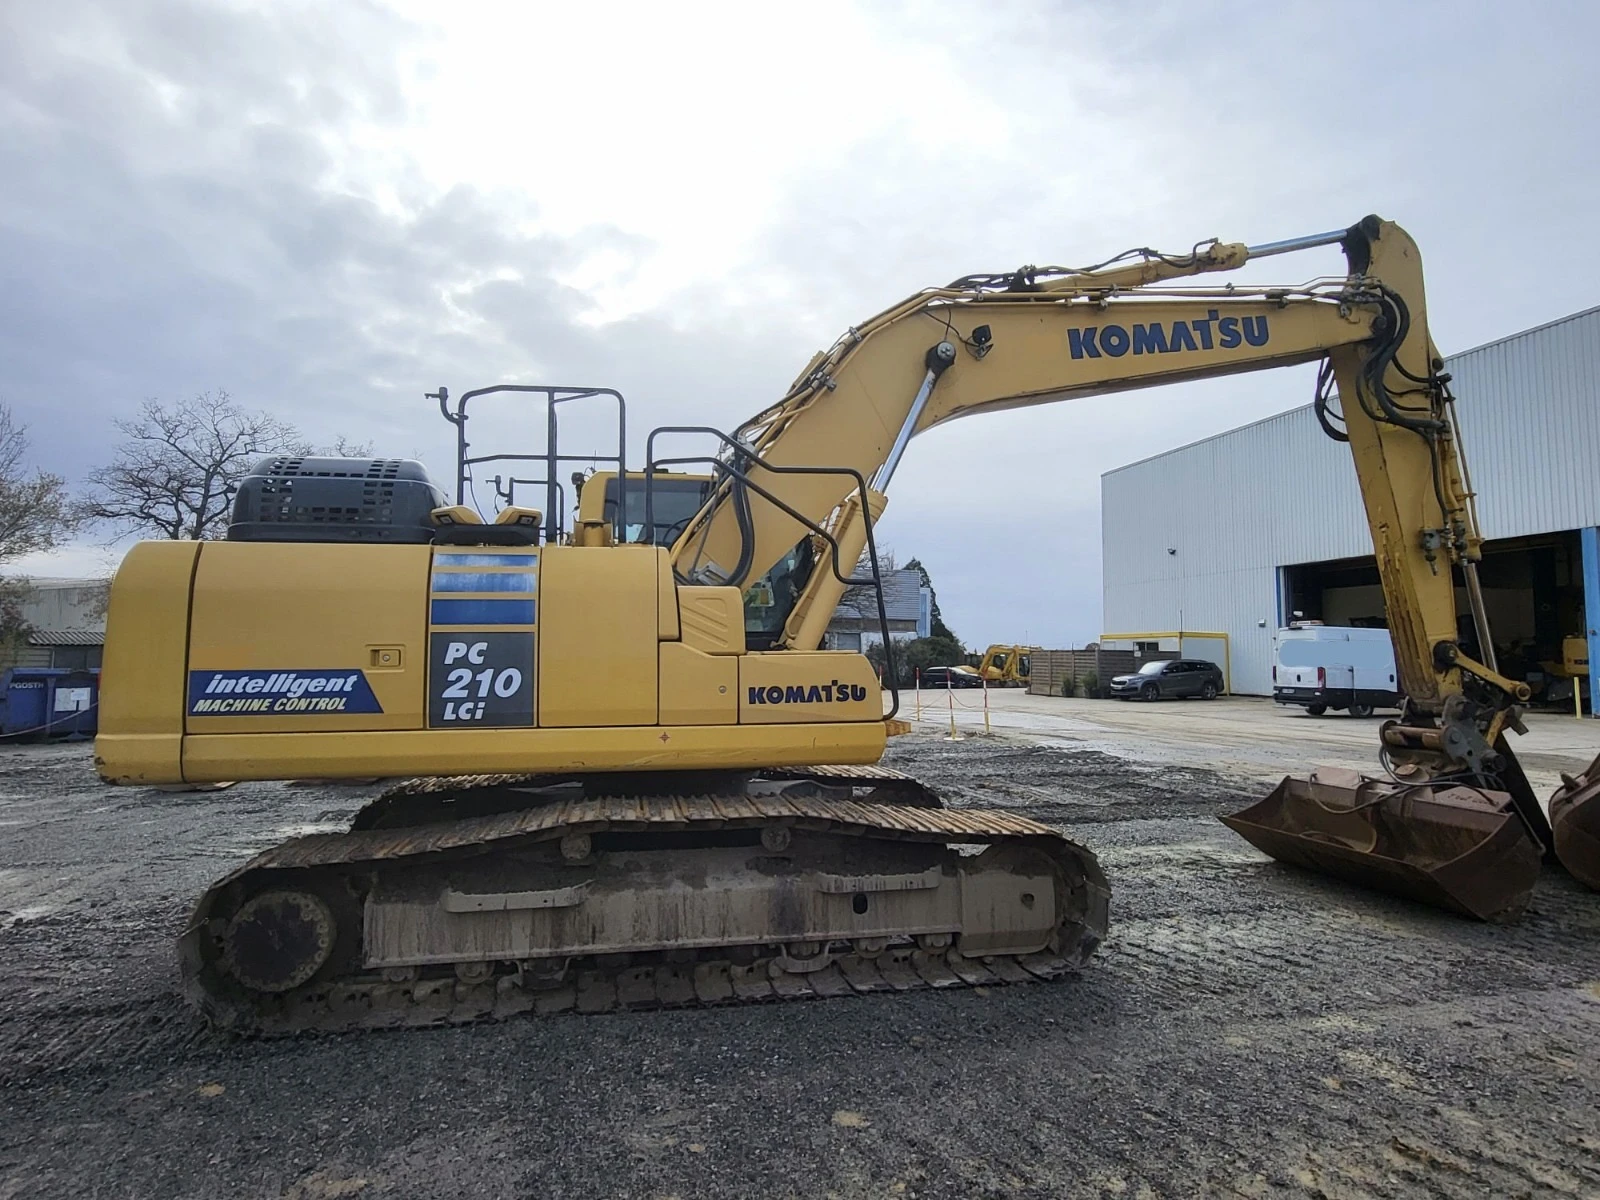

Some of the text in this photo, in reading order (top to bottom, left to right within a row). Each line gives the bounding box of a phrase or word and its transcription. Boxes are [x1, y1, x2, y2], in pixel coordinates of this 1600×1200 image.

[1067, 309, 1269, 360] KOMATSU
[444, 642, 488, 664] PC
[205, 674, 358, 697] intelligent
[441, 668, 522, 698] 210
[748, 680, 866, 704] KOMATSU
[193, 697, 347, 712] MACHINE CONTROL
[443, 702, 486, 720] LCi
